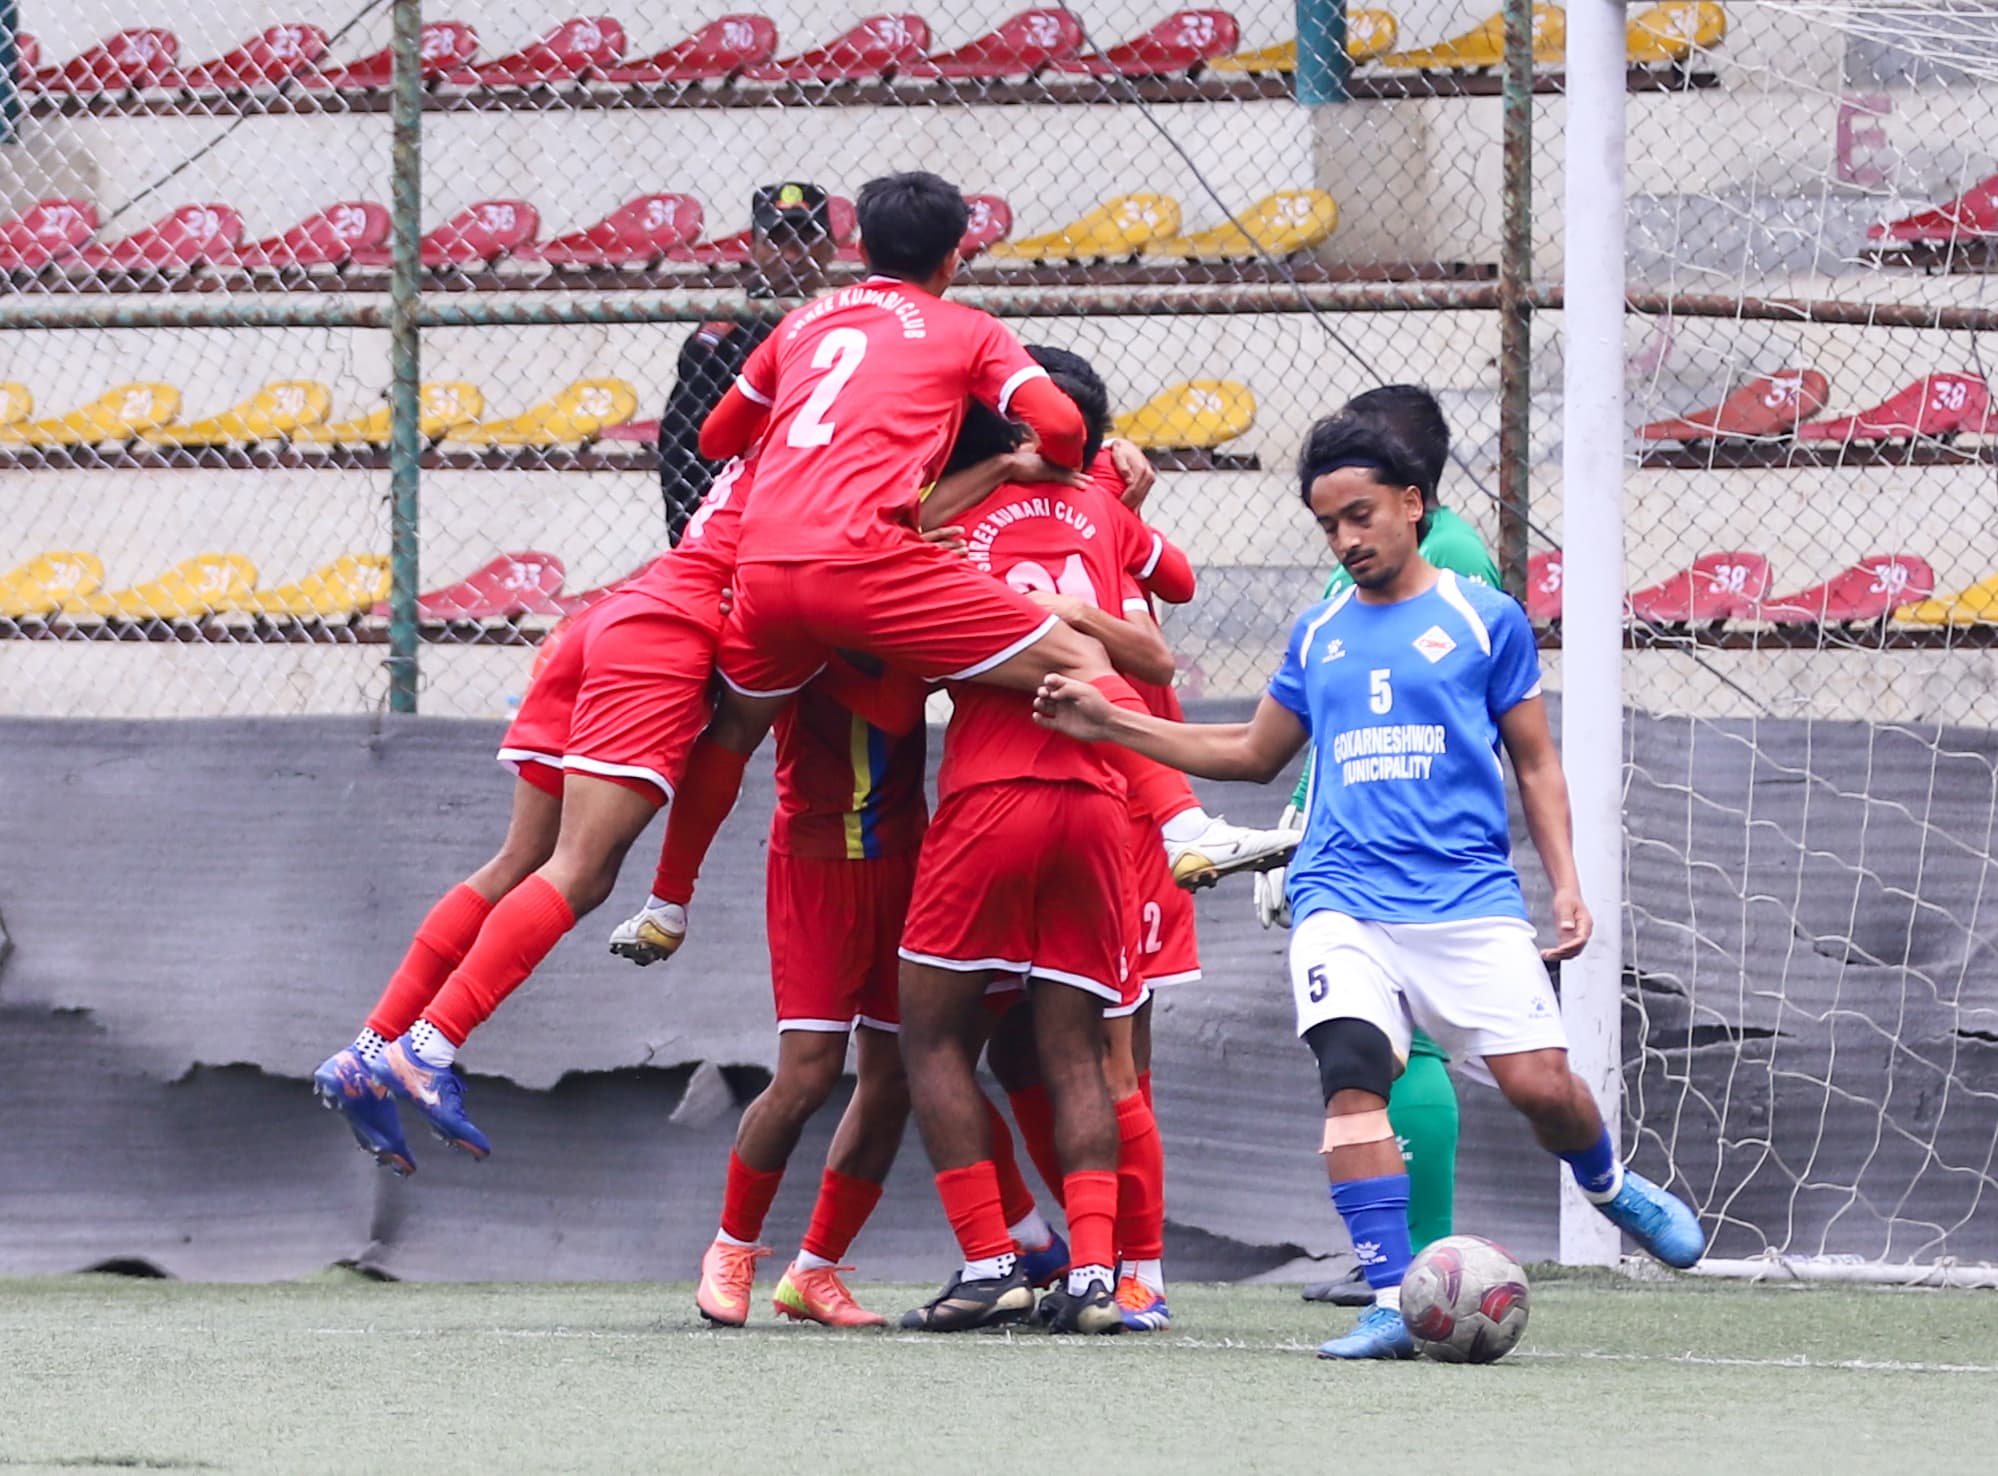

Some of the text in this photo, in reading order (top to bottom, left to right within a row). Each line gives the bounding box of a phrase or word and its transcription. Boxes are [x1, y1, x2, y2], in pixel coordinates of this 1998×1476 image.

[1026, 16, 1060, 47] 32
[1837, 96, 1893, 188] E
[334, 207, 366, 238] 29
[642, 199, 677, 230] 31
[966, 202, 991, 234] 3
[896, 302, 927, 339] CLUB
[786, 327, 868, 448] 2
[1932, 381, 1967, 411] 38
[987, 498, 1051, 527] KUMARI
[1055, 501, 1097, 540] CLUB
[1539, 563, 1562, 593] 3
[1709, 563, 1748, 594] 38
[1869, 563, 1908, 595] 39
[1369, 668, 1393, 715] 5
[1307, 964, 1329, 1003] 5
